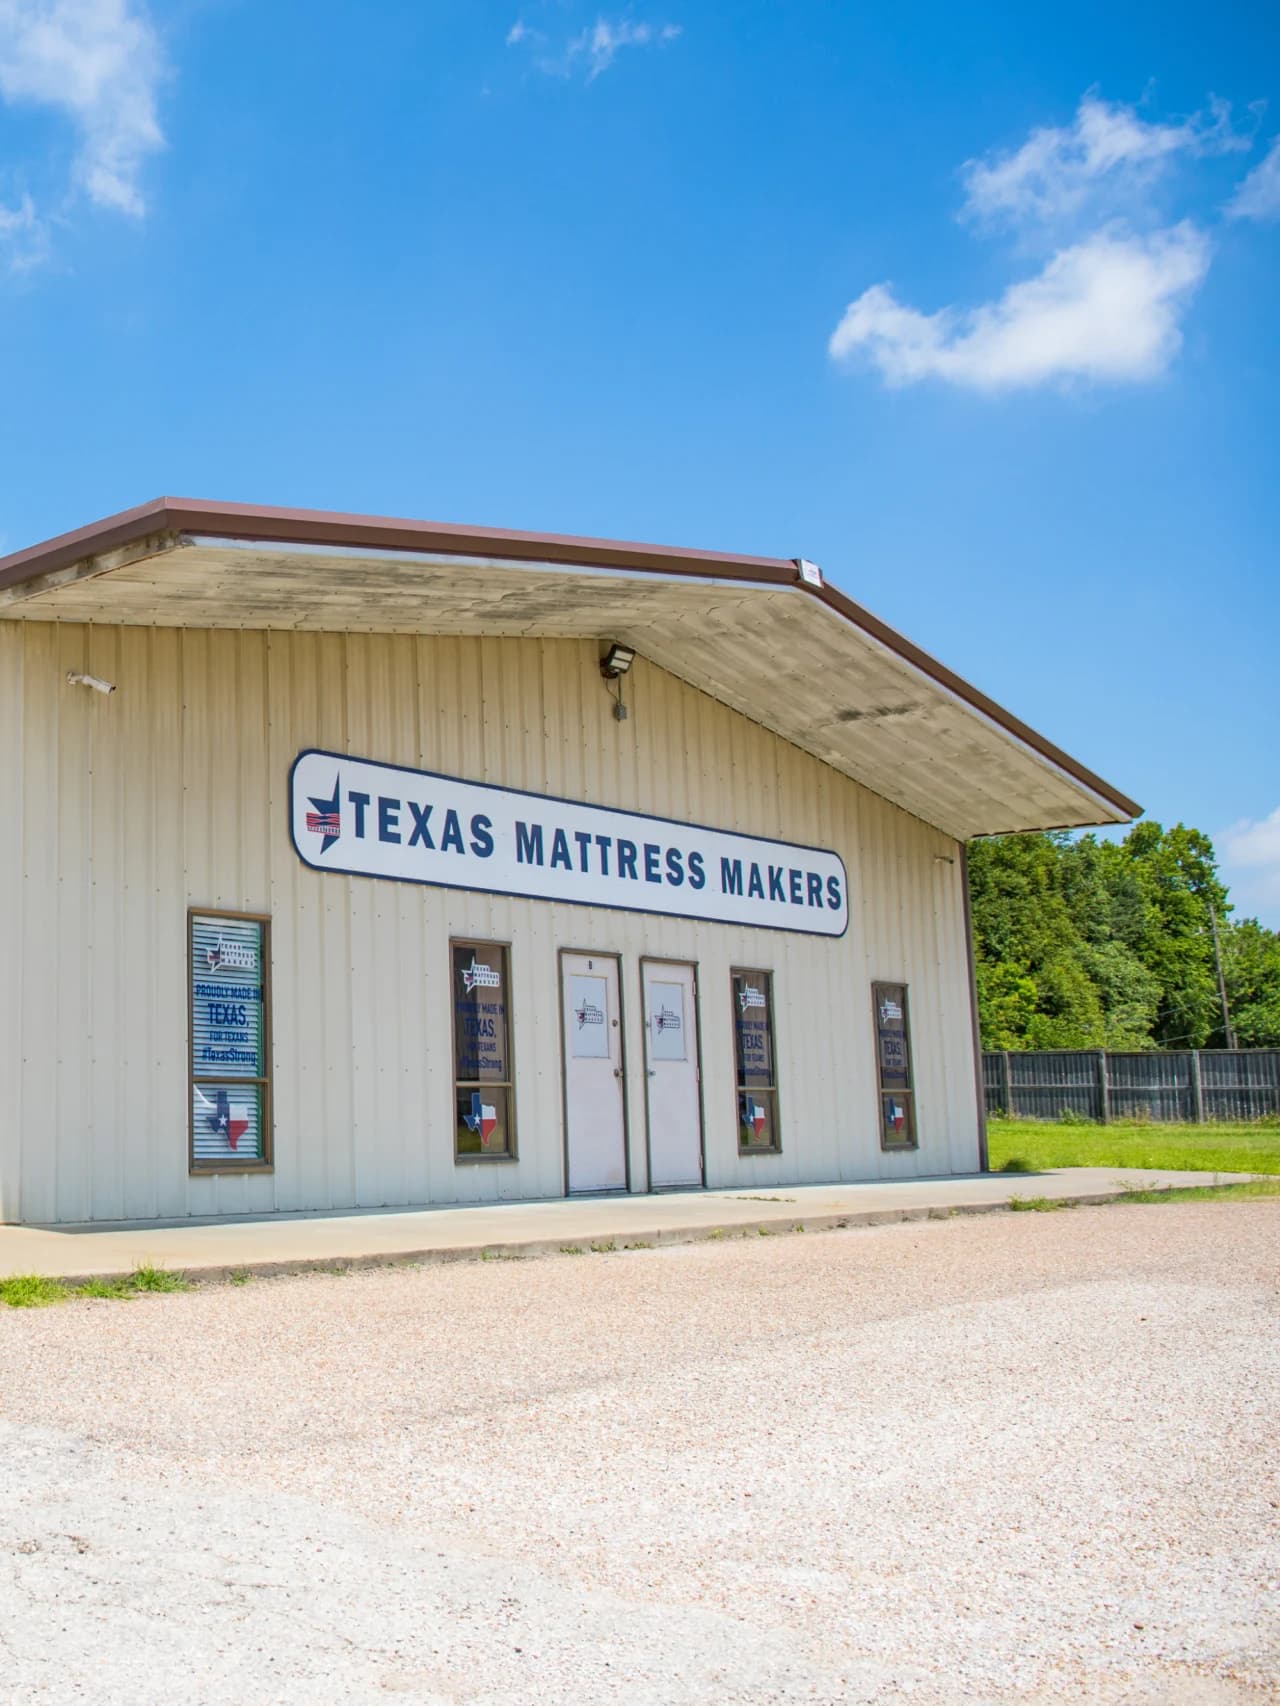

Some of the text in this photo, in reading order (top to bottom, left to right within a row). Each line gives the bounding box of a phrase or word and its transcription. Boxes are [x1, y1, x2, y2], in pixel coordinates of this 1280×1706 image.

[348, 791, 842, 911] TEXAS MATTRESS MAKERS
[195, 984, 229, 998] PROUDLY
[231, 986, 251, 1000] MADE
